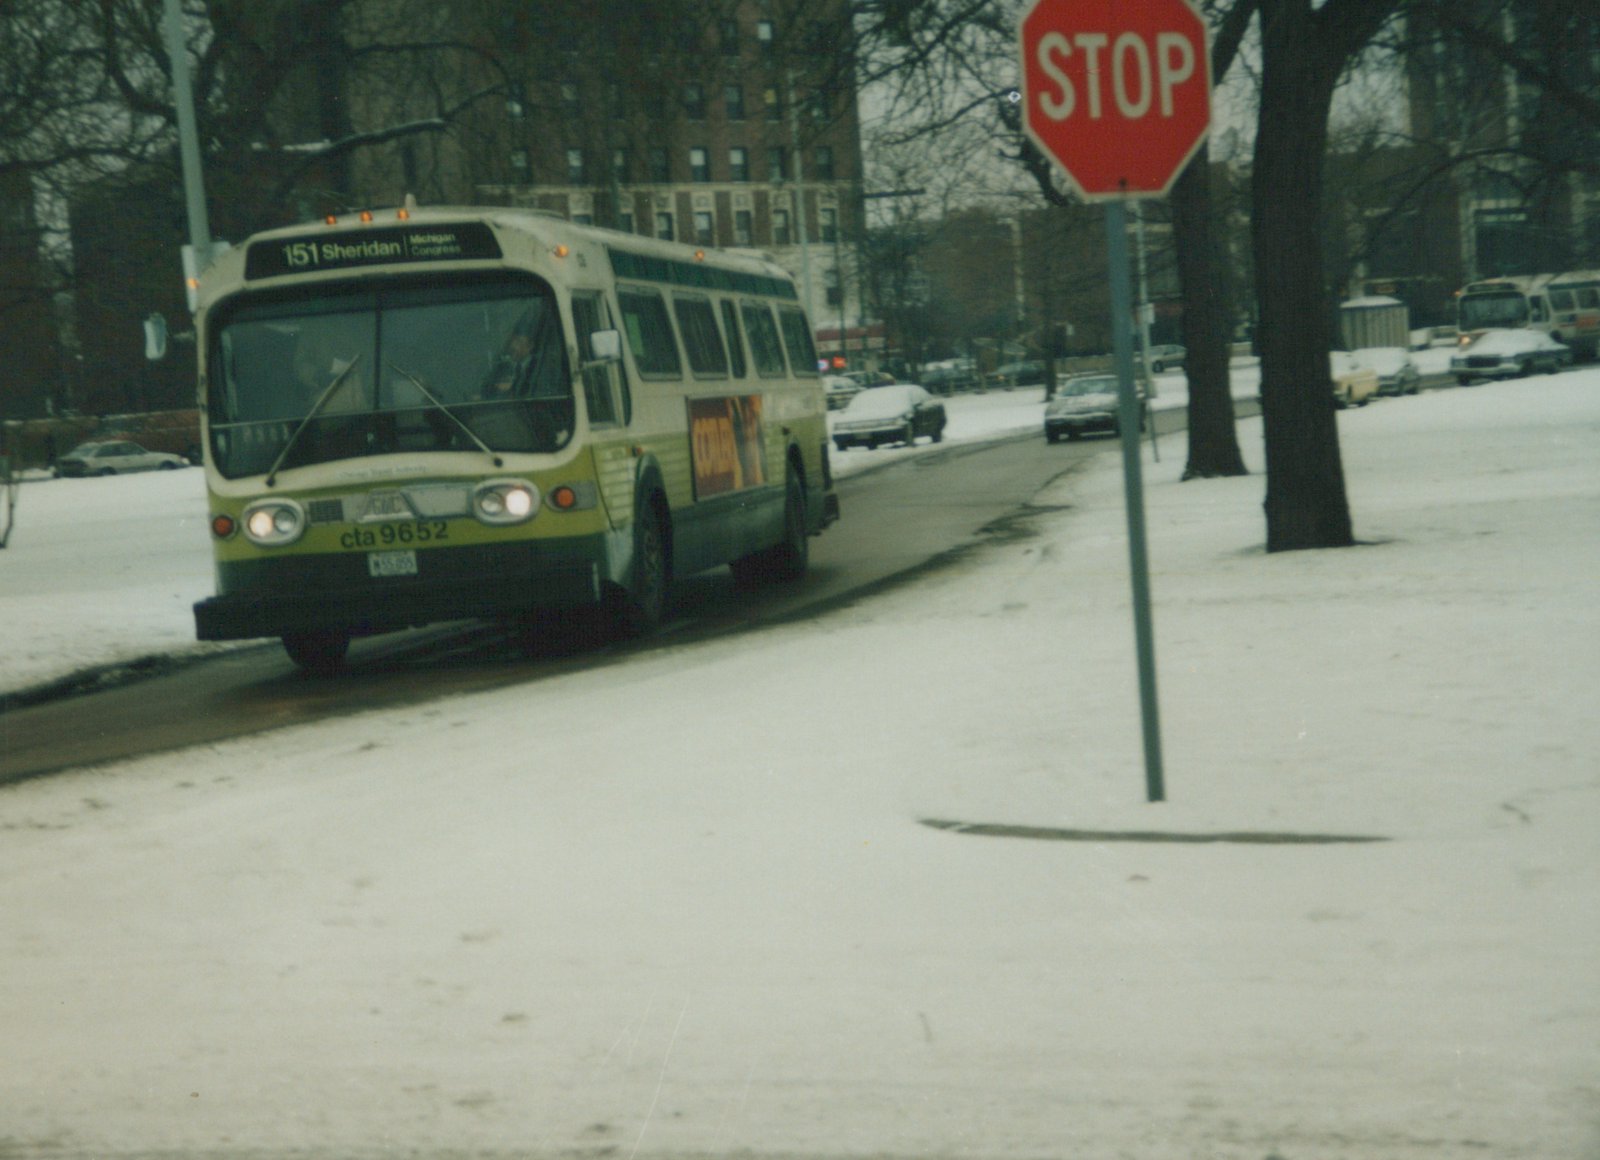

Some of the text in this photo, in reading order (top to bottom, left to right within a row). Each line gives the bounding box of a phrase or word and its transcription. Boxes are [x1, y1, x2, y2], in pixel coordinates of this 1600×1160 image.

[1036, 30, 1195, 122] STOP
[409, 233, 456, 245] Michigan
[411, 244, 462, 256] Congress
[284, 240, 401, 267] 151 Sheridan
[340, 521, 449, 549] cta 9652
